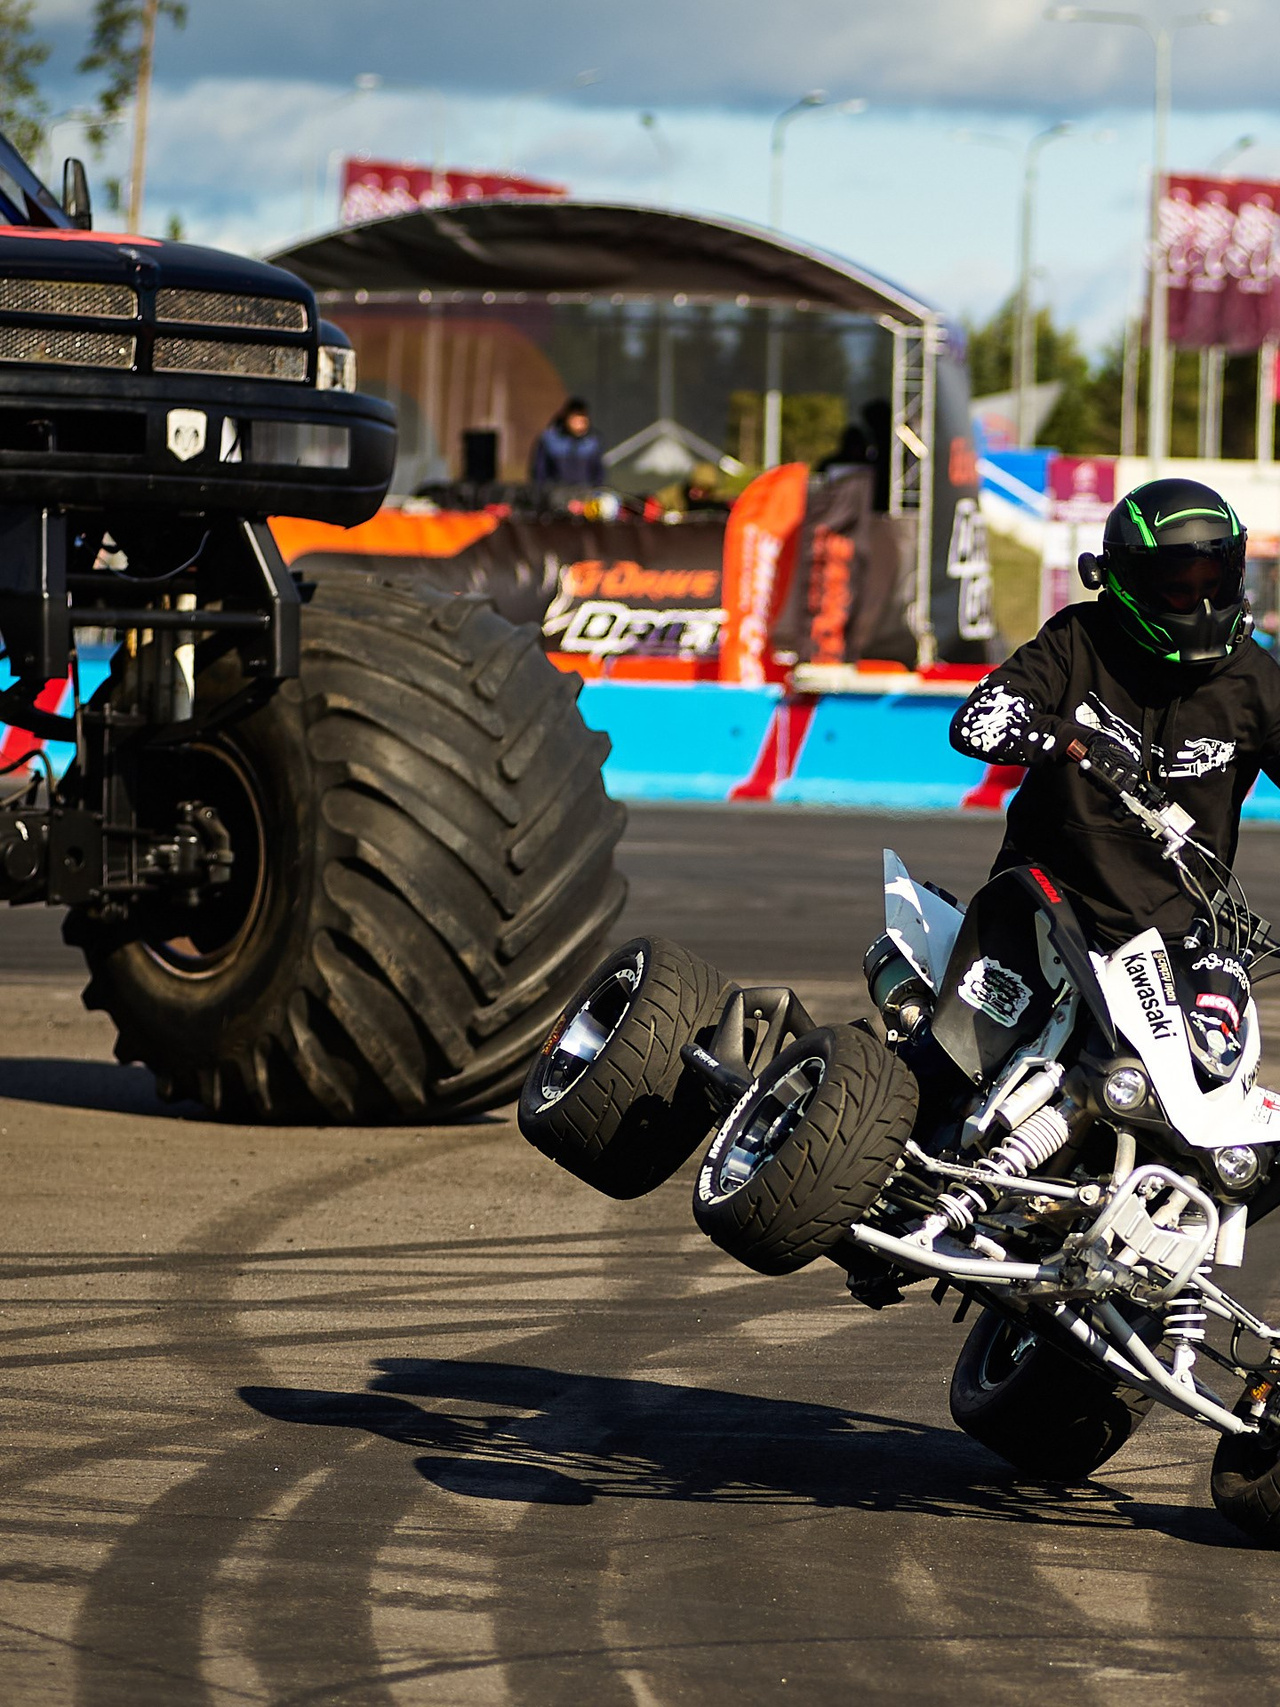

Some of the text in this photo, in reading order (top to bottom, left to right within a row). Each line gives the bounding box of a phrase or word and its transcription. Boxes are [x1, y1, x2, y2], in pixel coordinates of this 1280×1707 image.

[1029, 868, 1062, 904] KENDA
[1121, 952, 1178, 1040] Kawasaki
[699, 1078, 759, 1201] STUNT MOSCOW
